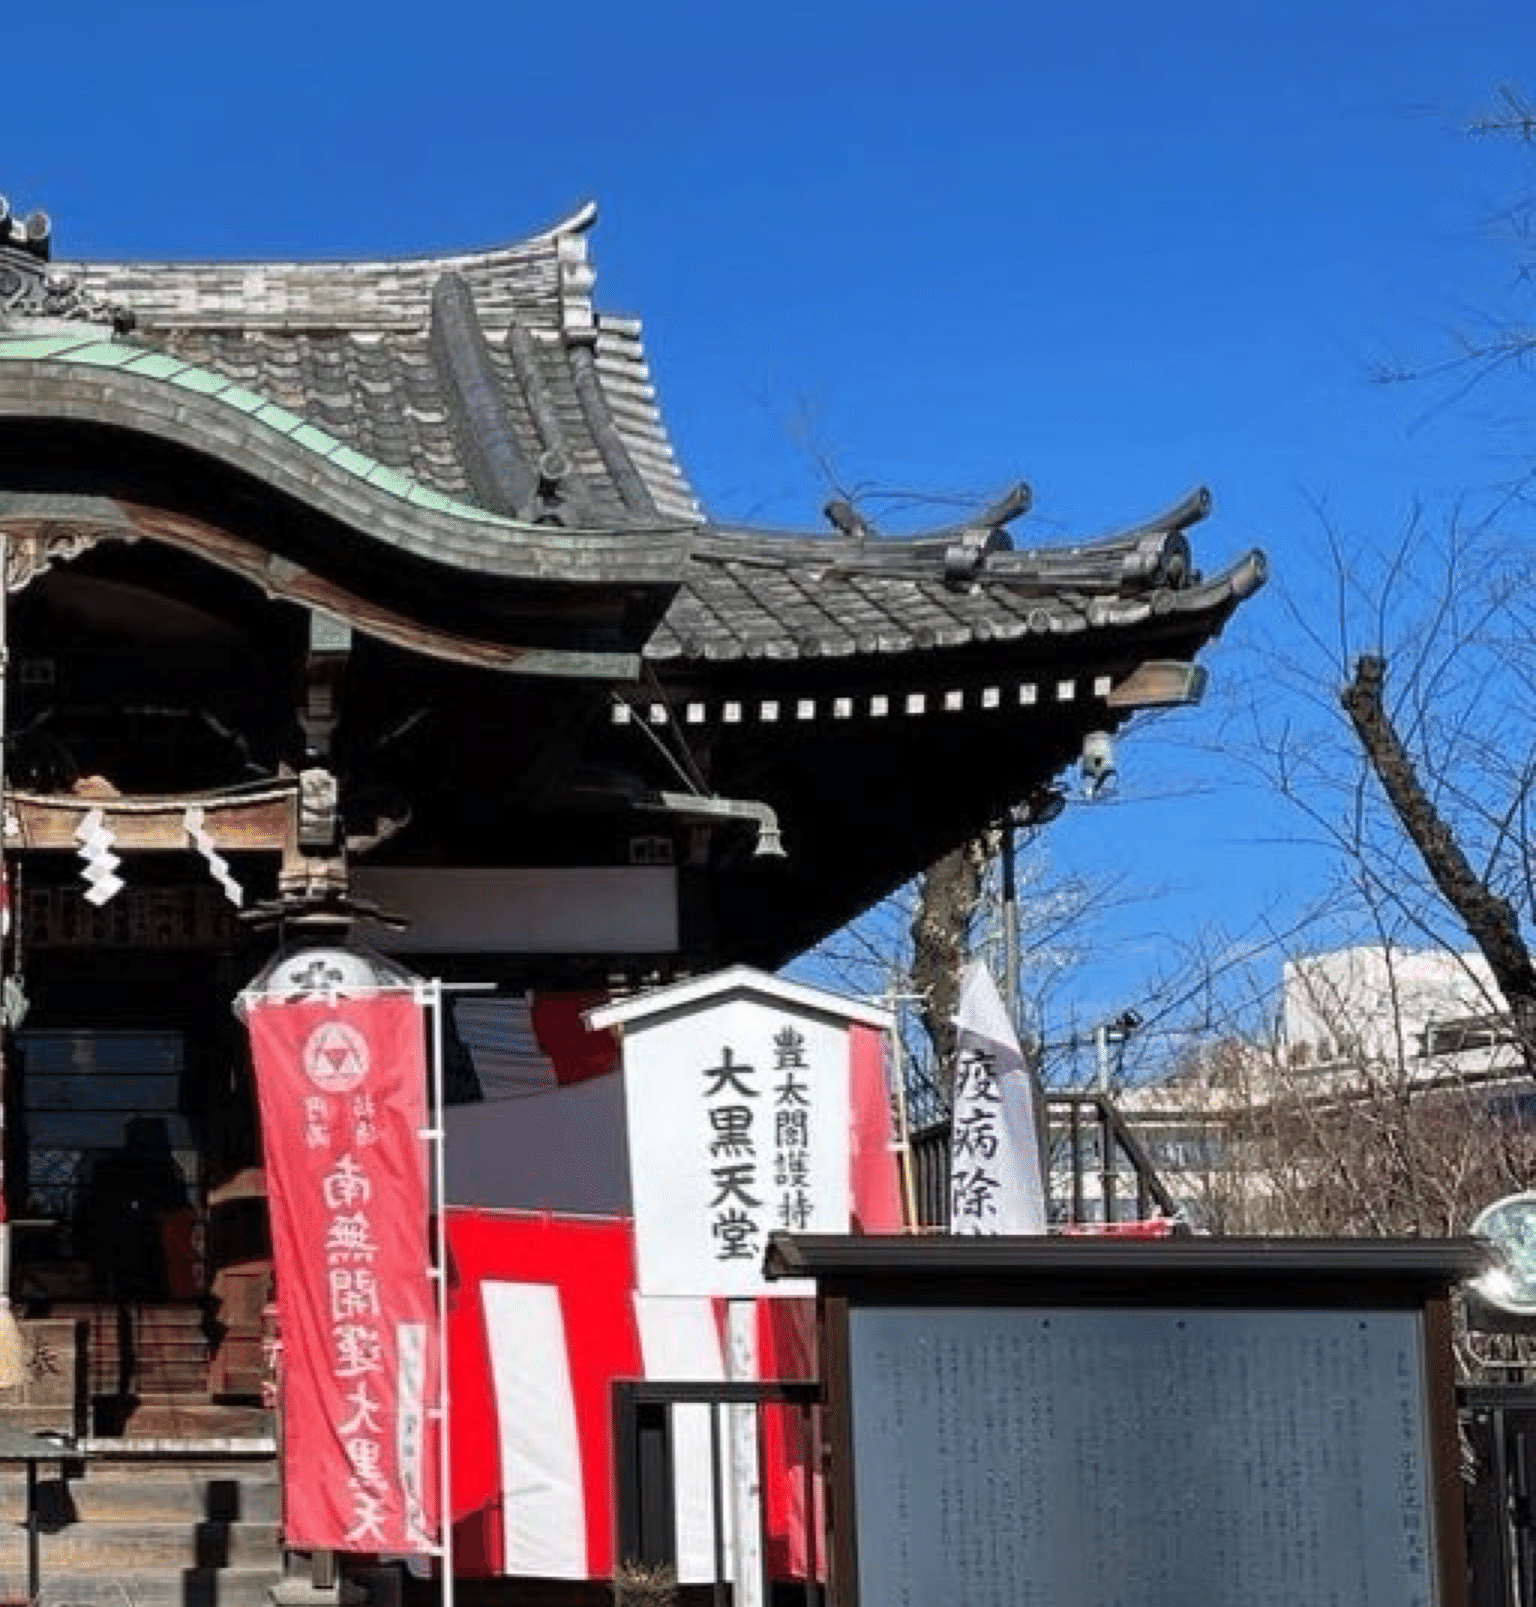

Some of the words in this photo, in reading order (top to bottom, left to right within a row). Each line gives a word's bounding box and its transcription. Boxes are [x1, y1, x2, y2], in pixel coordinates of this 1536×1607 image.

[702, 1046, 763, 1261] 大黒天堂
[952, 1049, 1004, 1235] 疫病除
